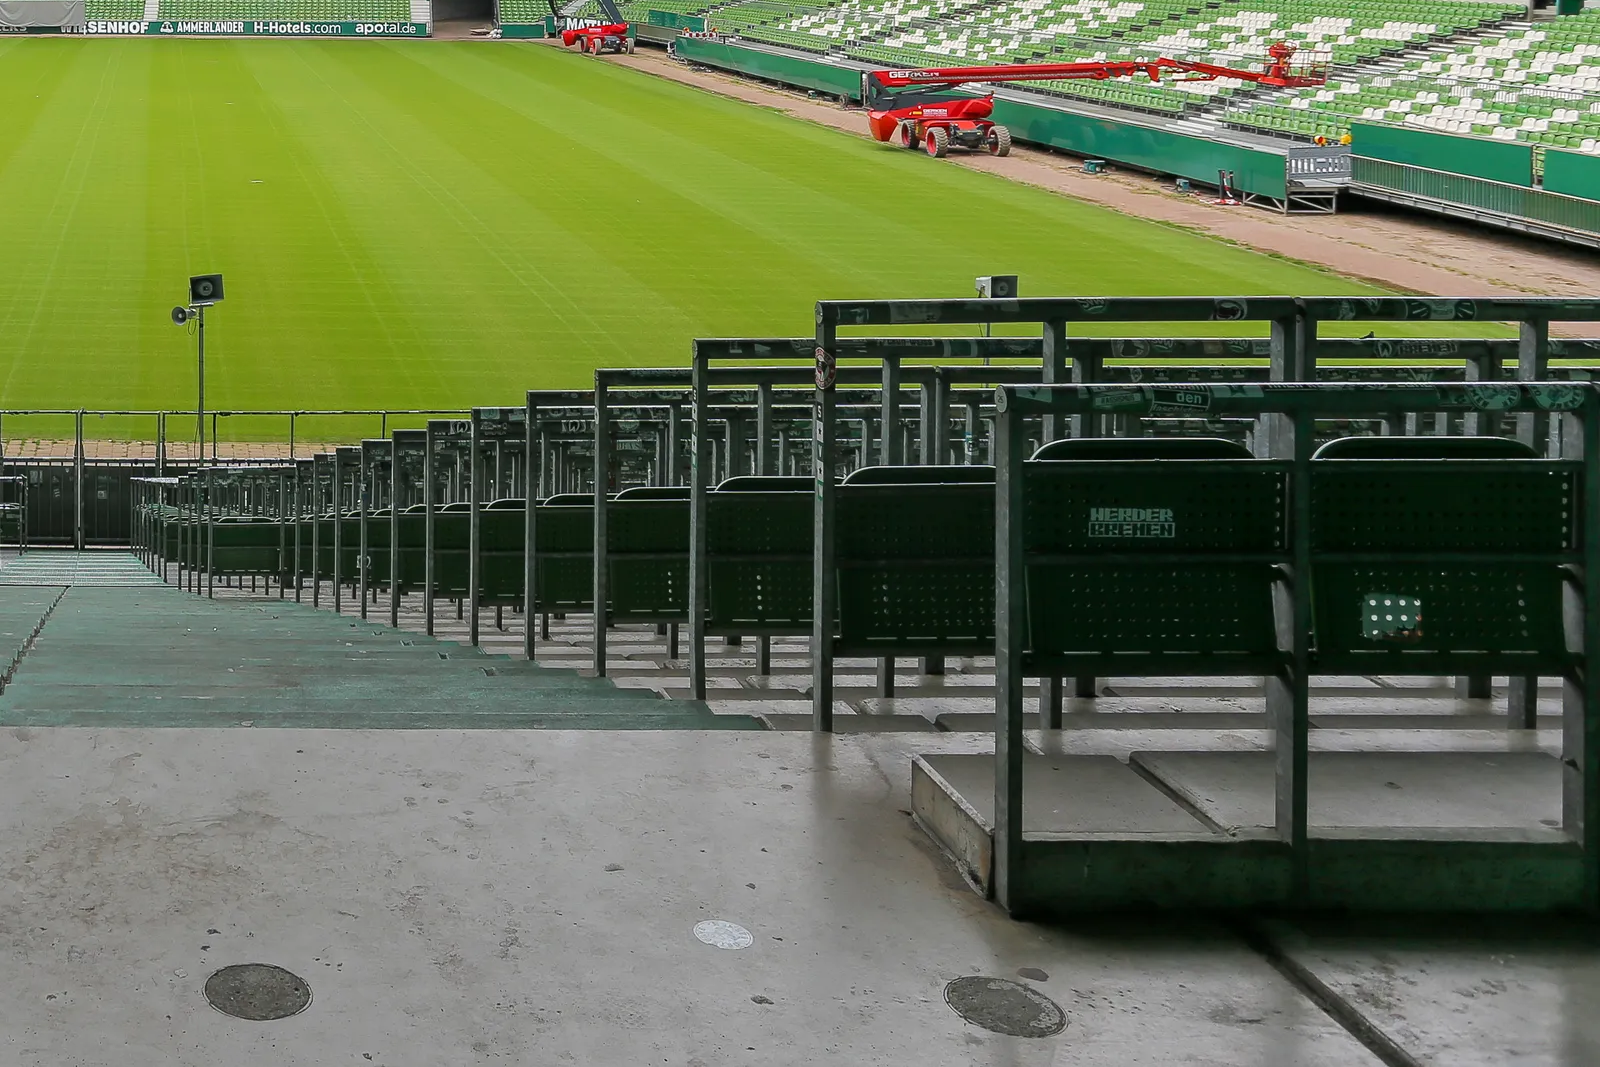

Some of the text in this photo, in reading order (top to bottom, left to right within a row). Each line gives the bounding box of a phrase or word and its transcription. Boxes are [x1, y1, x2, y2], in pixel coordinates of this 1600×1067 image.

[177, 20, 243, 33] AMMERLÄNDER
[254, 20, 341, 34] H-Hotels.com
[355, 21, 416, 35] apotal.de
[1176, 393, 1202, 404] den
